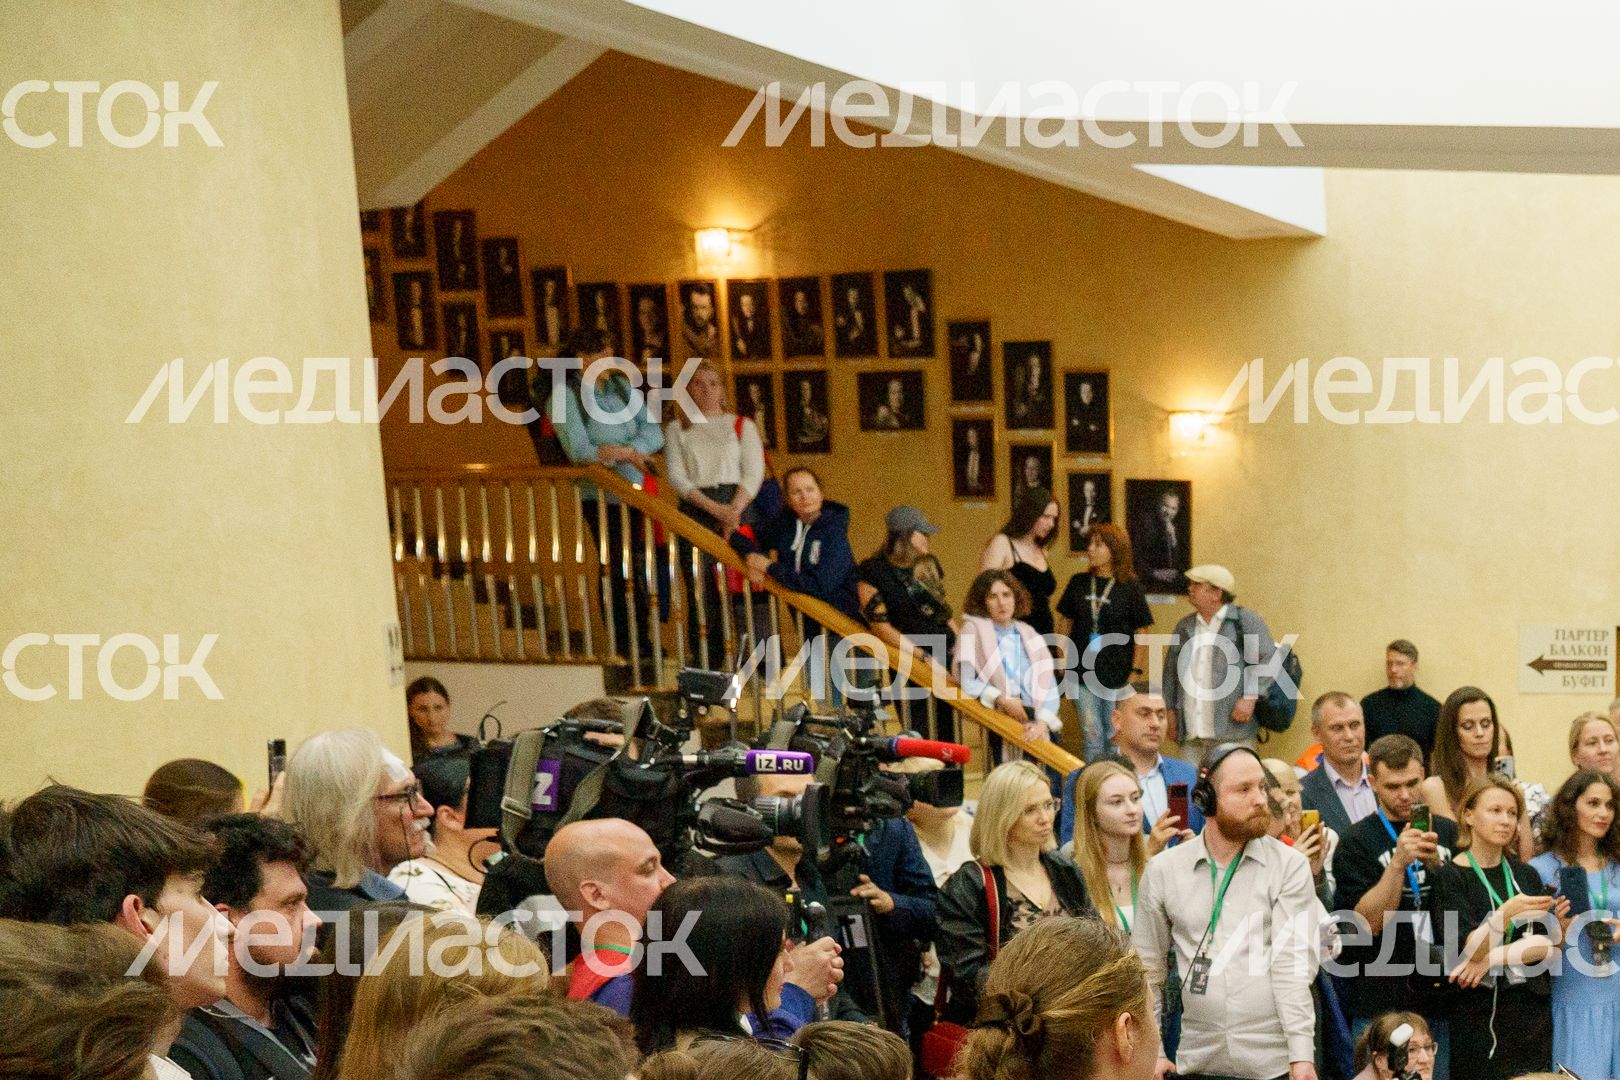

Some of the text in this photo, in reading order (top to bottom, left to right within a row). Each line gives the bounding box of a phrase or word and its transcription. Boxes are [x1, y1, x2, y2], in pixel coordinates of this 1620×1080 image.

[1555, 629, 1608, 641] ПАРТЕР
[1549, 644, 1608, 656] БАЛКОН
[1562, 675, 1606, 689] БУФЕТ
